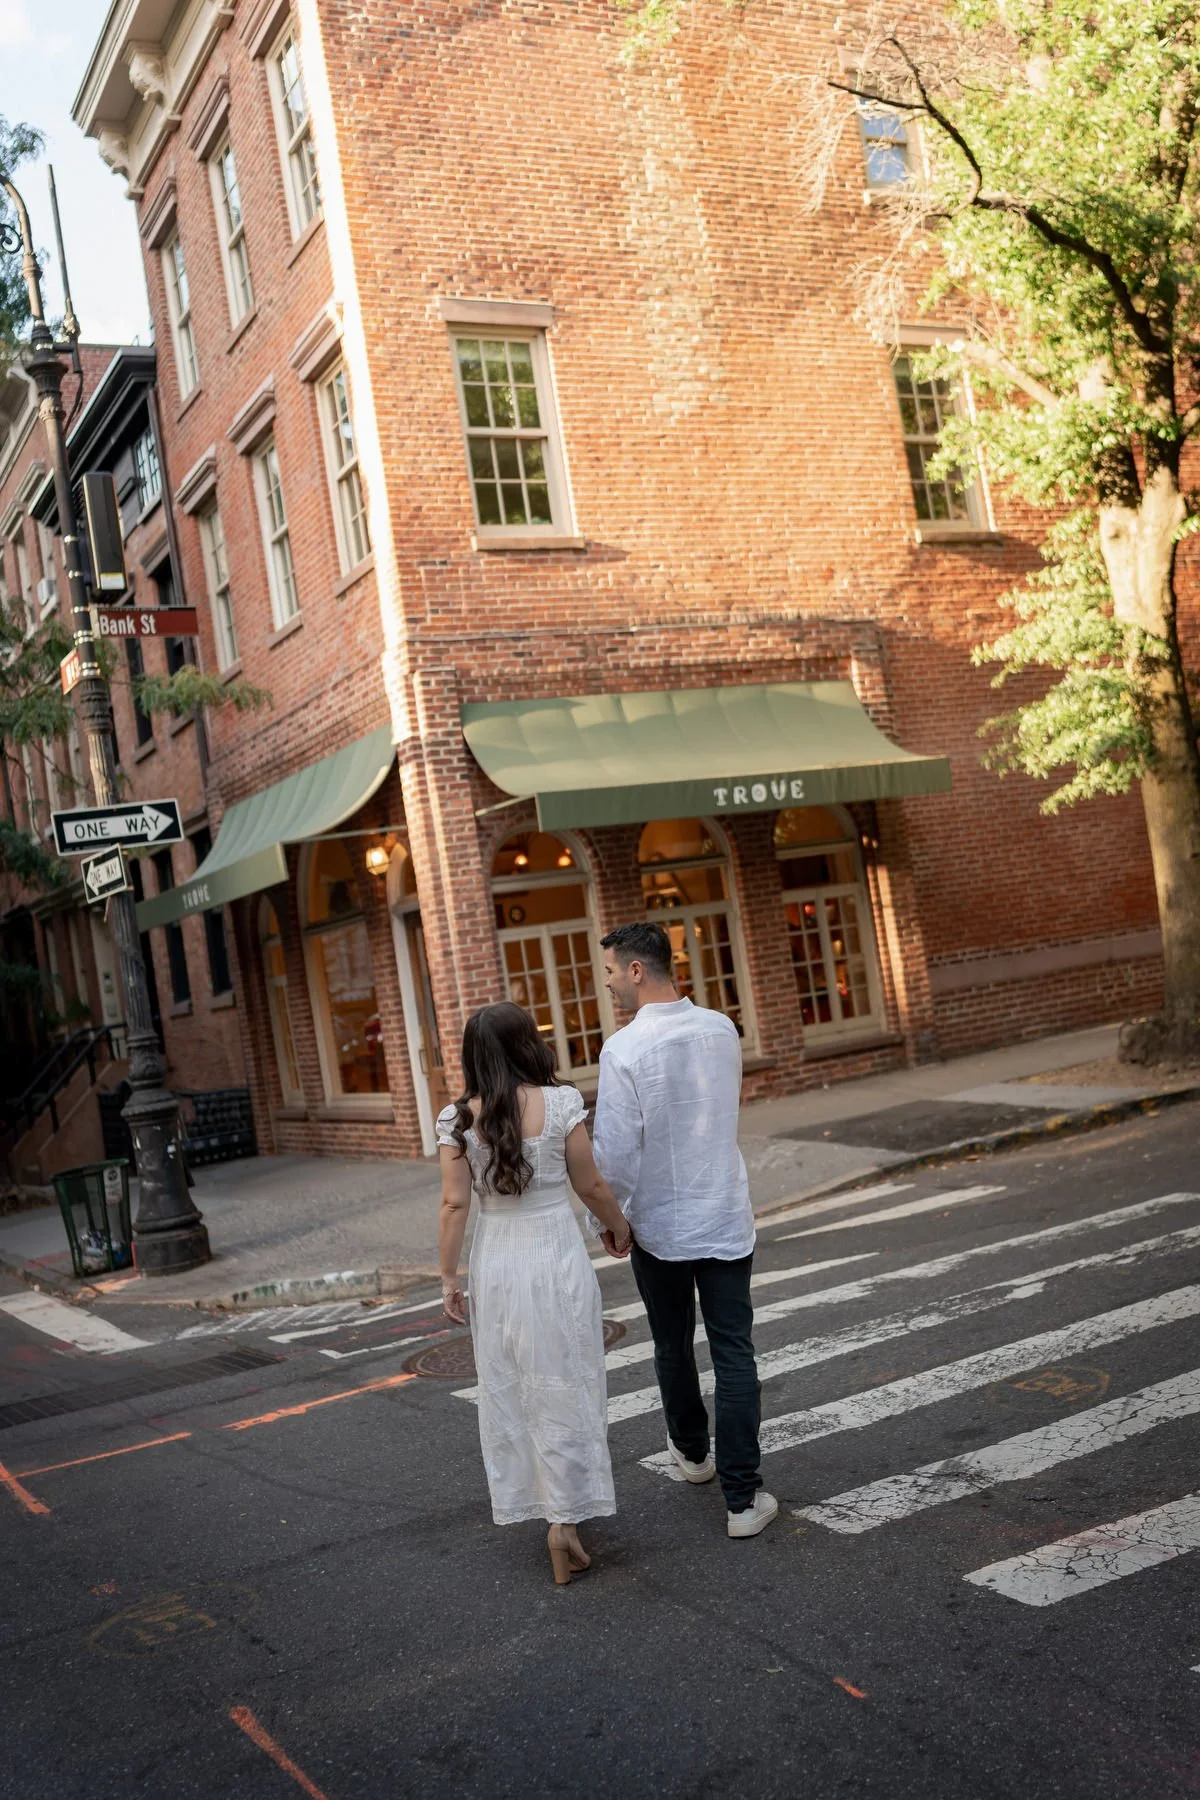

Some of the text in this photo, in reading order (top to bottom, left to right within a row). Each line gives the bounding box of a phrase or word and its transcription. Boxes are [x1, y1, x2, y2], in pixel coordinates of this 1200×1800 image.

[100, 614, 156, 635] Bank St
[713, 779, 804, 806] TROVE
[74, 815, 159, 839] ONE WAY
